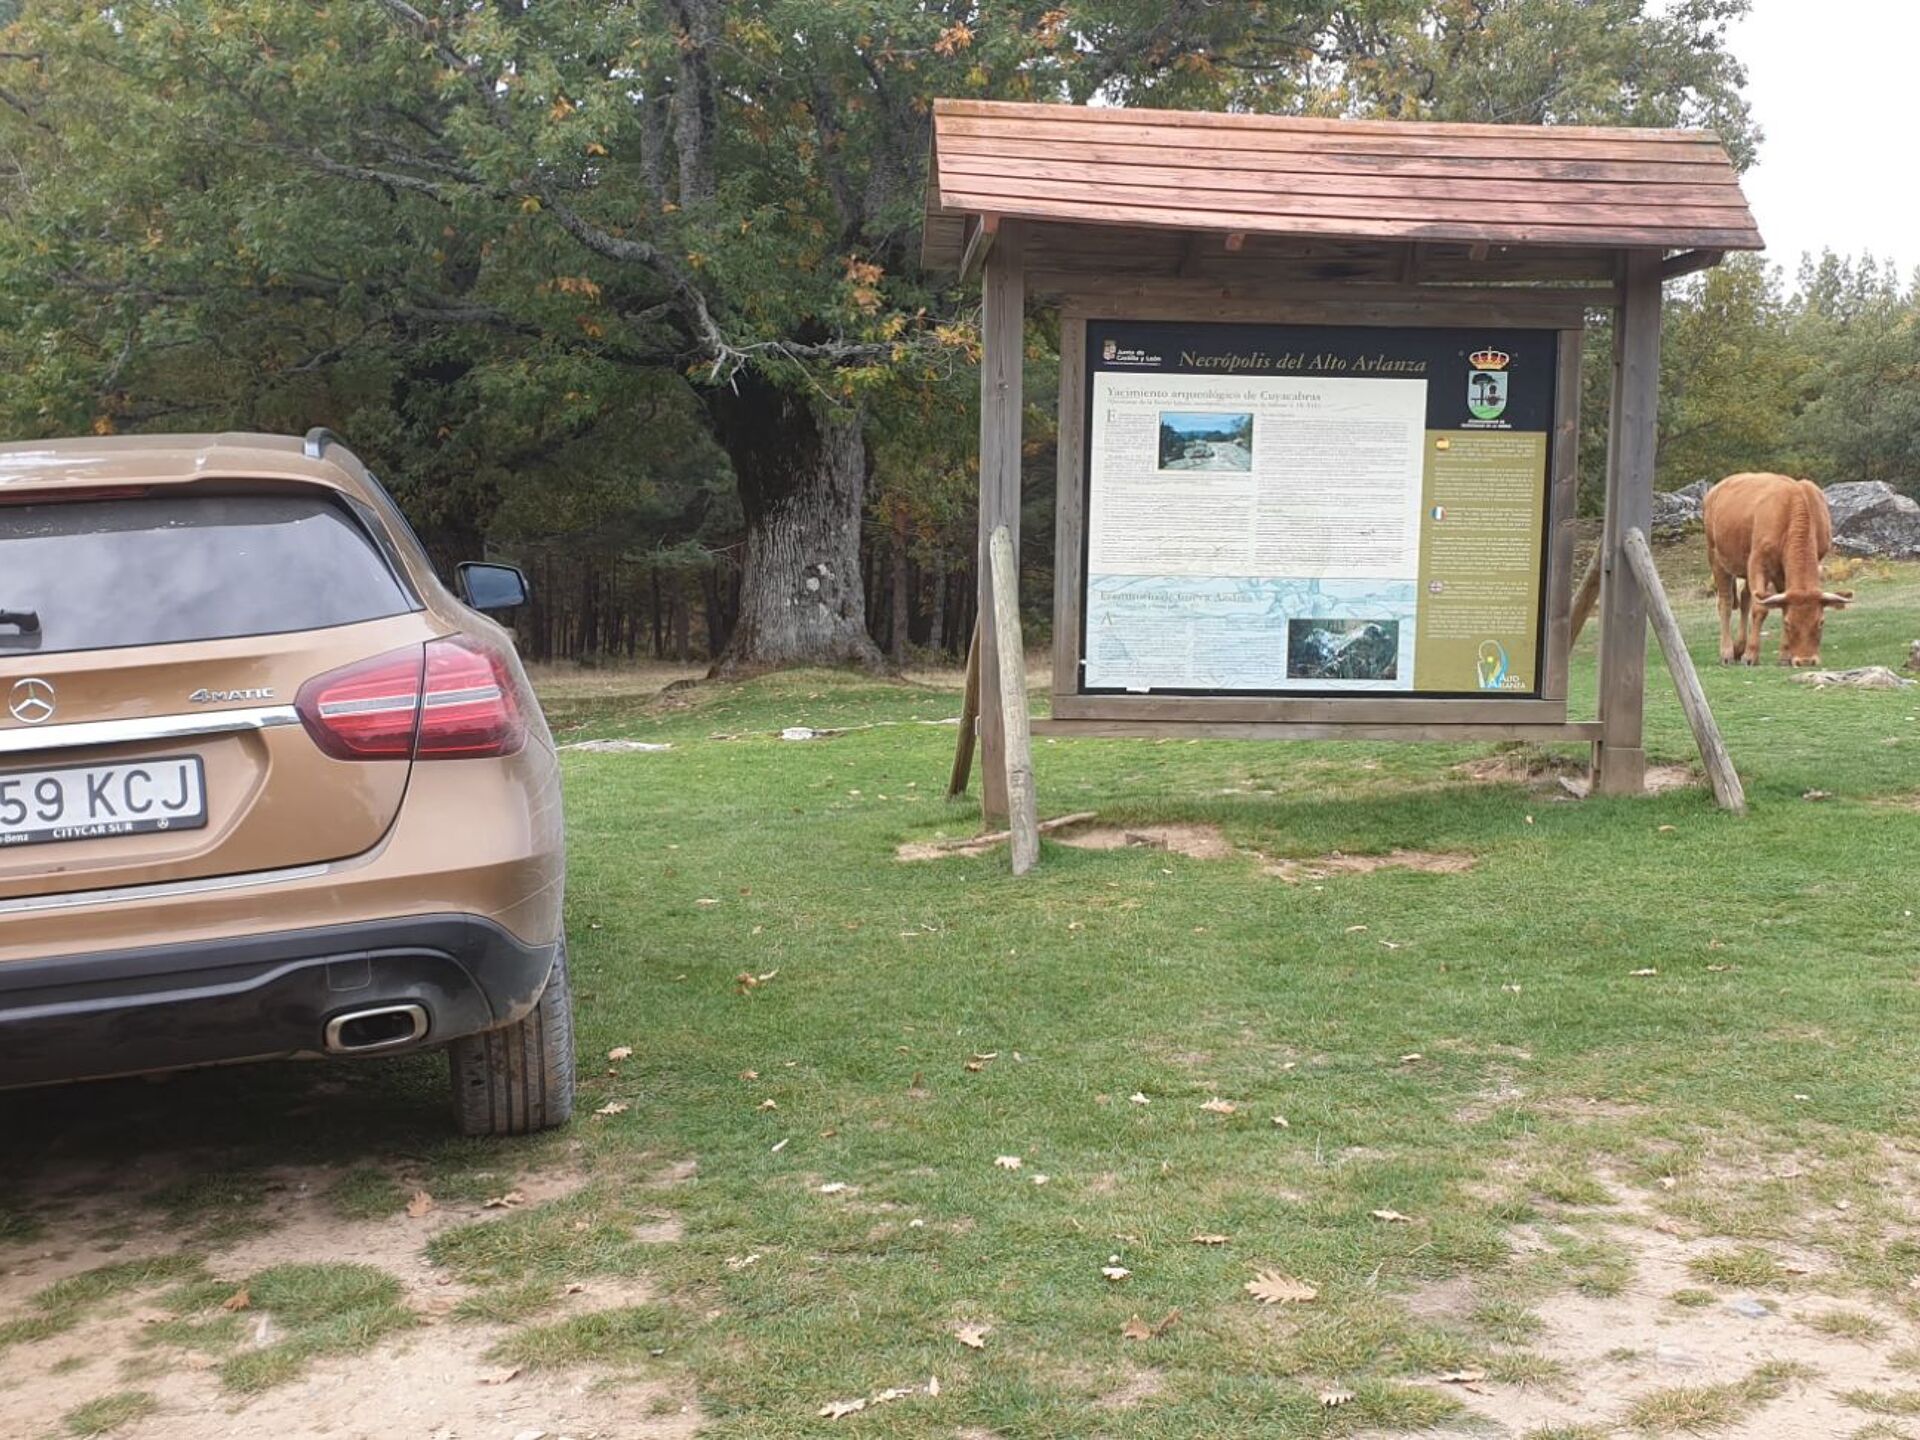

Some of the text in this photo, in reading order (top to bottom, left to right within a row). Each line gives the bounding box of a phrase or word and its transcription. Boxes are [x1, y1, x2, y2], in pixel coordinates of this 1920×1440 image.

[1178, 351, 1427, 372] Necrópolis del Alto Arlanza
[188, 687, 275, 702] 4MATIC
[87, 765, 188, 818] KCJ
[53, 823, 106, 838] CITYCAR
[109, 822, 133, 833] SUR
